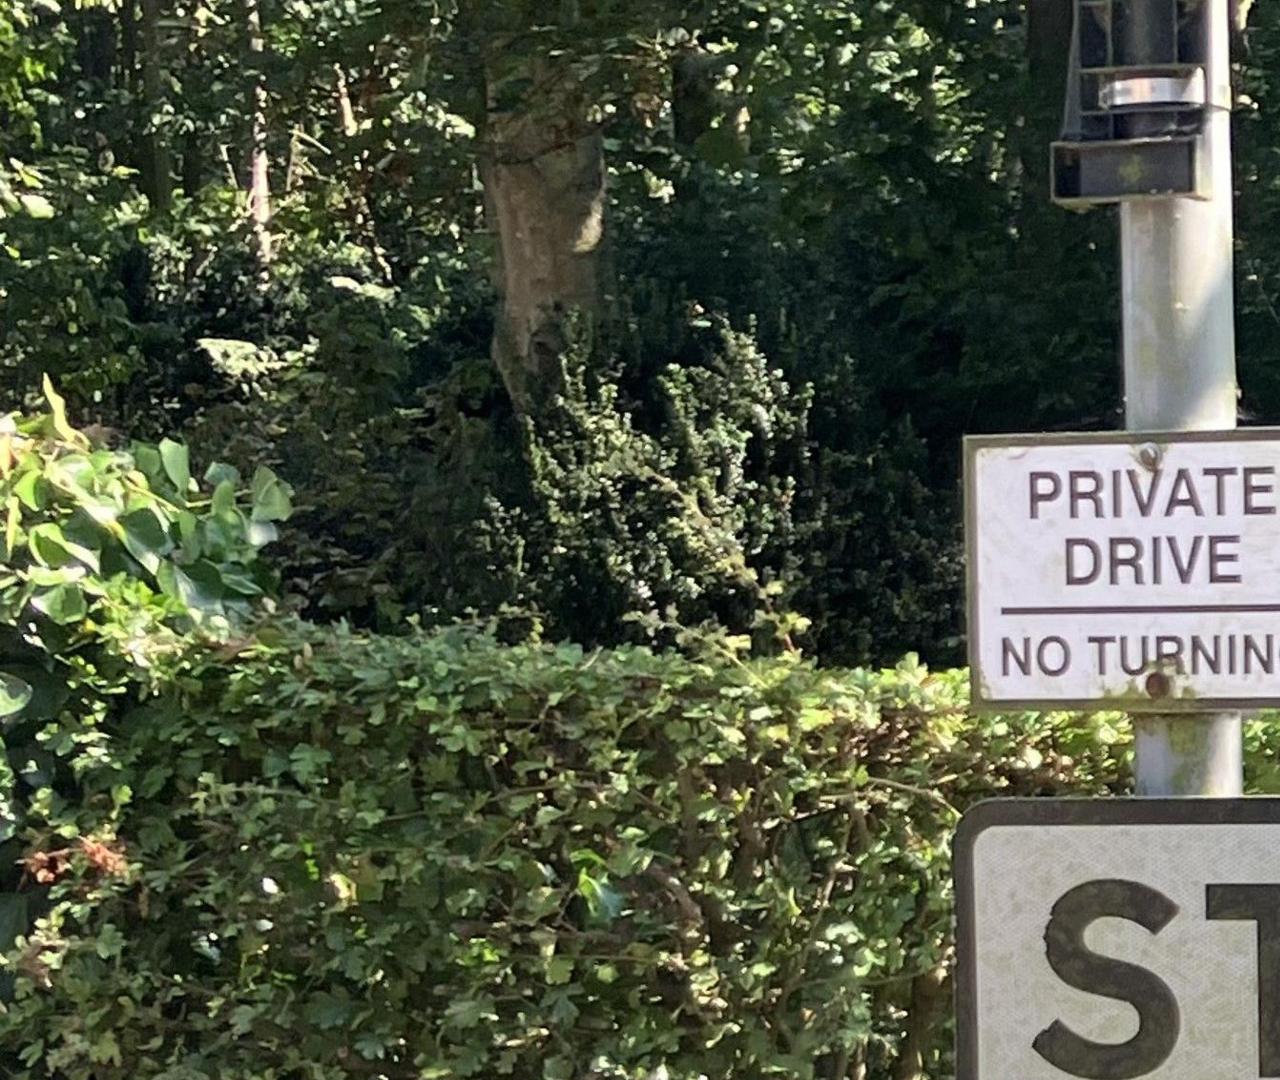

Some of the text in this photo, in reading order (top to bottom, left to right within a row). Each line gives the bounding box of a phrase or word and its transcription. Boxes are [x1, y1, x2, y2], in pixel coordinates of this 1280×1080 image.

[1027, 466, 1277, 520] PRIVATE
[1064, 534, 1243, 586] DRIVE
[1001, 634, 1072, 677] NO
